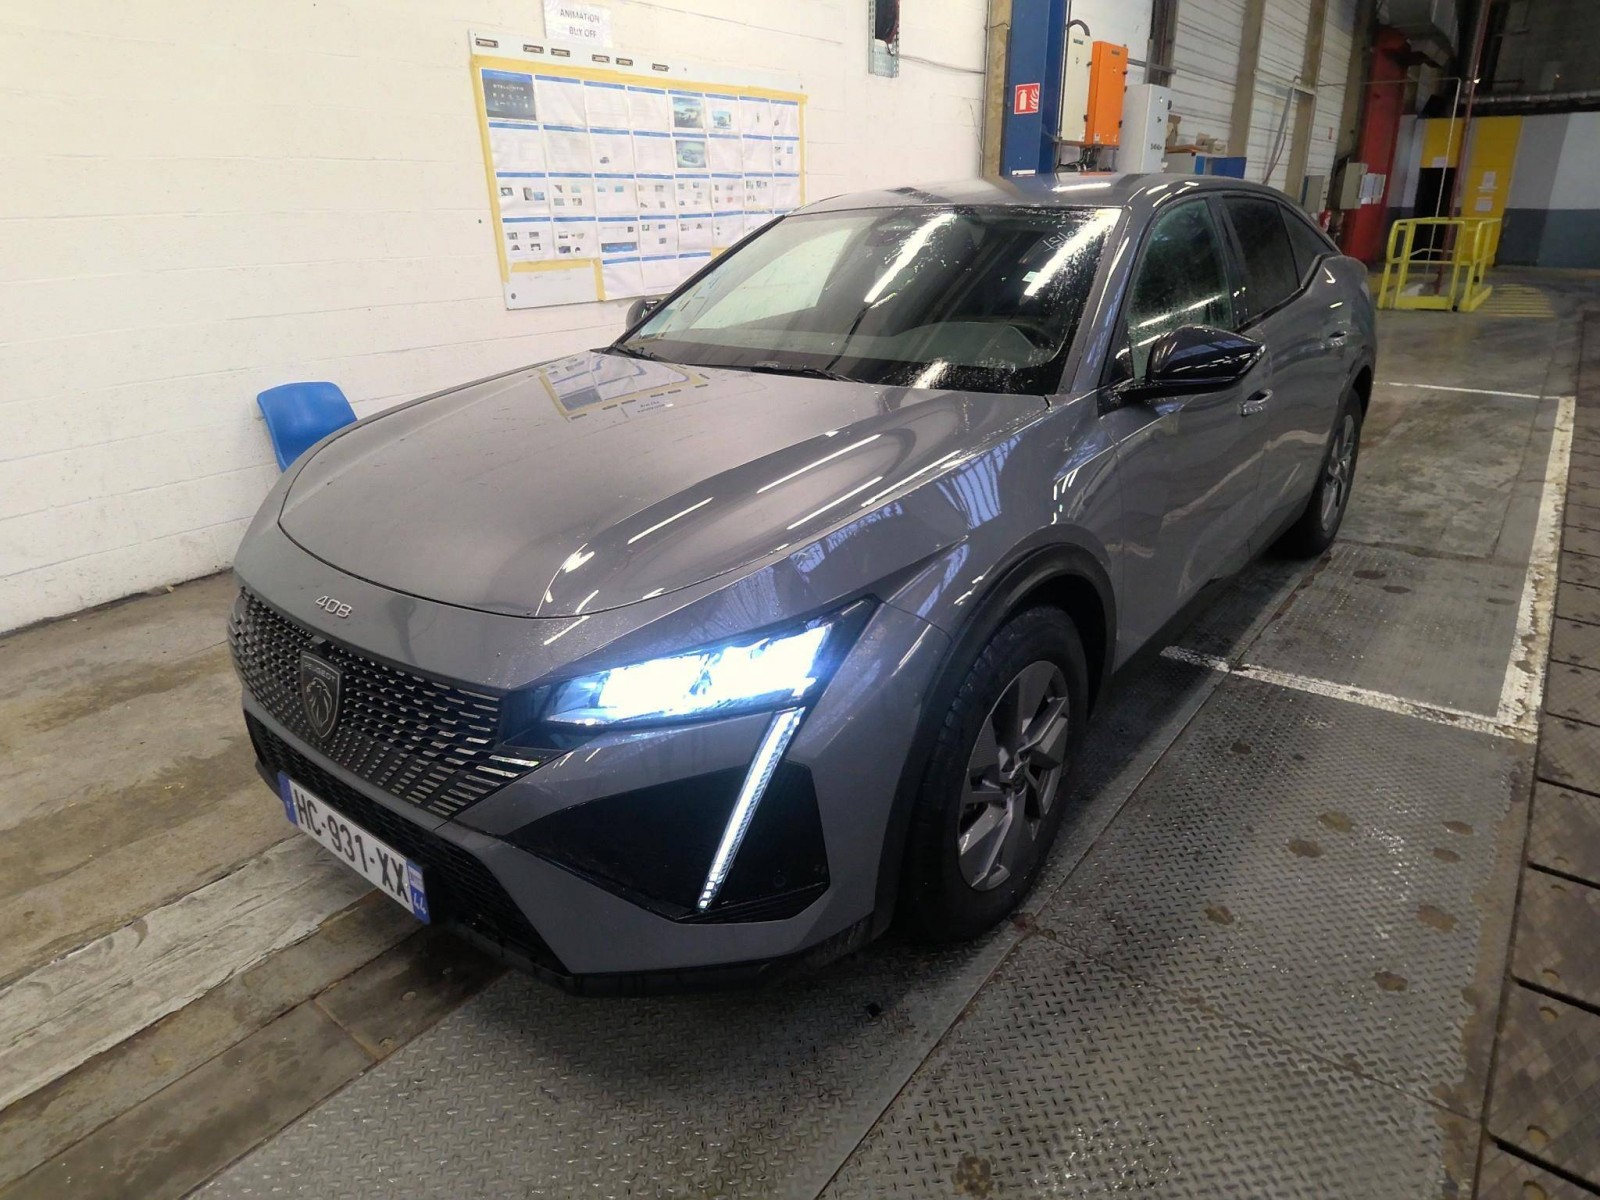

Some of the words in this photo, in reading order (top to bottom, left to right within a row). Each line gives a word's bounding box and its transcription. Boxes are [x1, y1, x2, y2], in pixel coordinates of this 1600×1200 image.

[560, 8, 600, 23] ANIMATION
[569, 26, 583, 37] BUY
[584, 29, 597, 39] OFF
[315, 595, 353, 619] 408
[294, 789, 409, 903] HC-931-XX
[413, 892, 427, 915] 44
